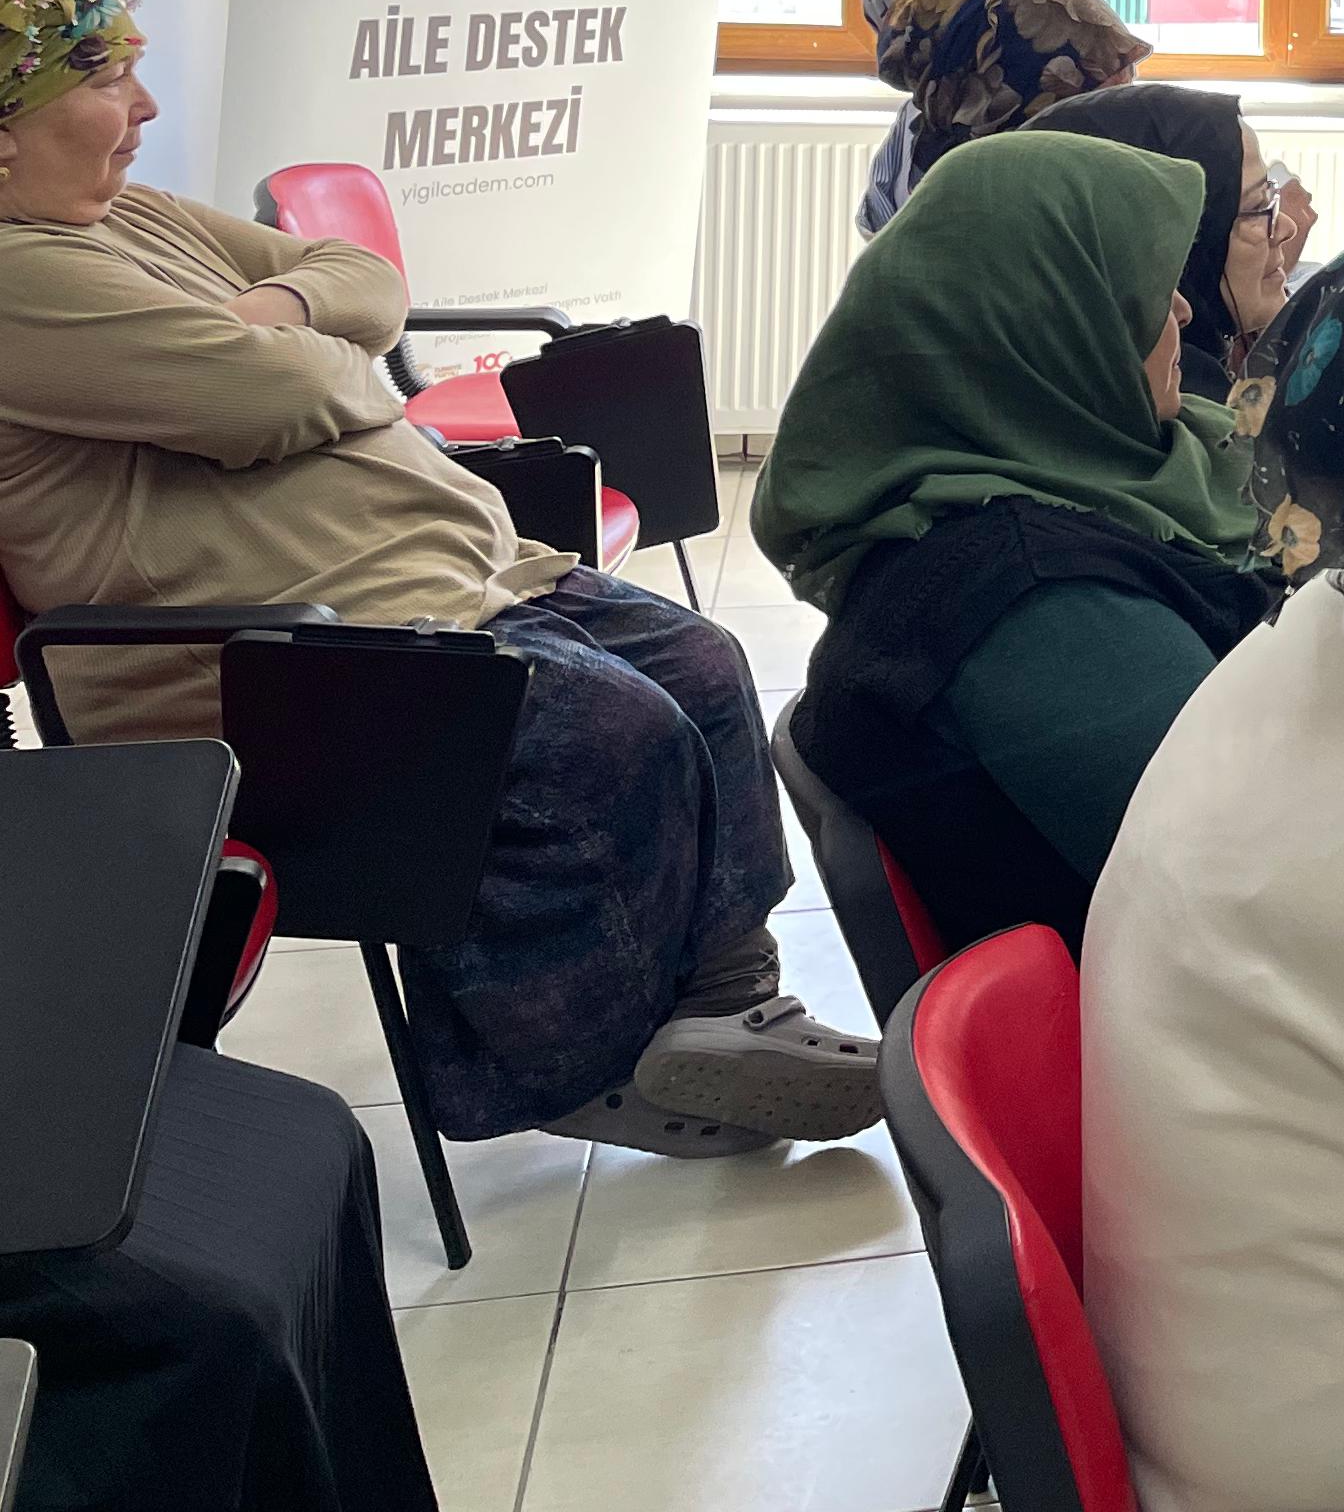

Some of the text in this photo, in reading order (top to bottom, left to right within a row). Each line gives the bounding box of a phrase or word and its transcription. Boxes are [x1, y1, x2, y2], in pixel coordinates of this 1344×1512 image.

[348, 3, 629, 81] AİLE DESTEK
[381, 84, 585, 172] MERKEZİ
[401, 172, 555, 207] yigilcadem.com
